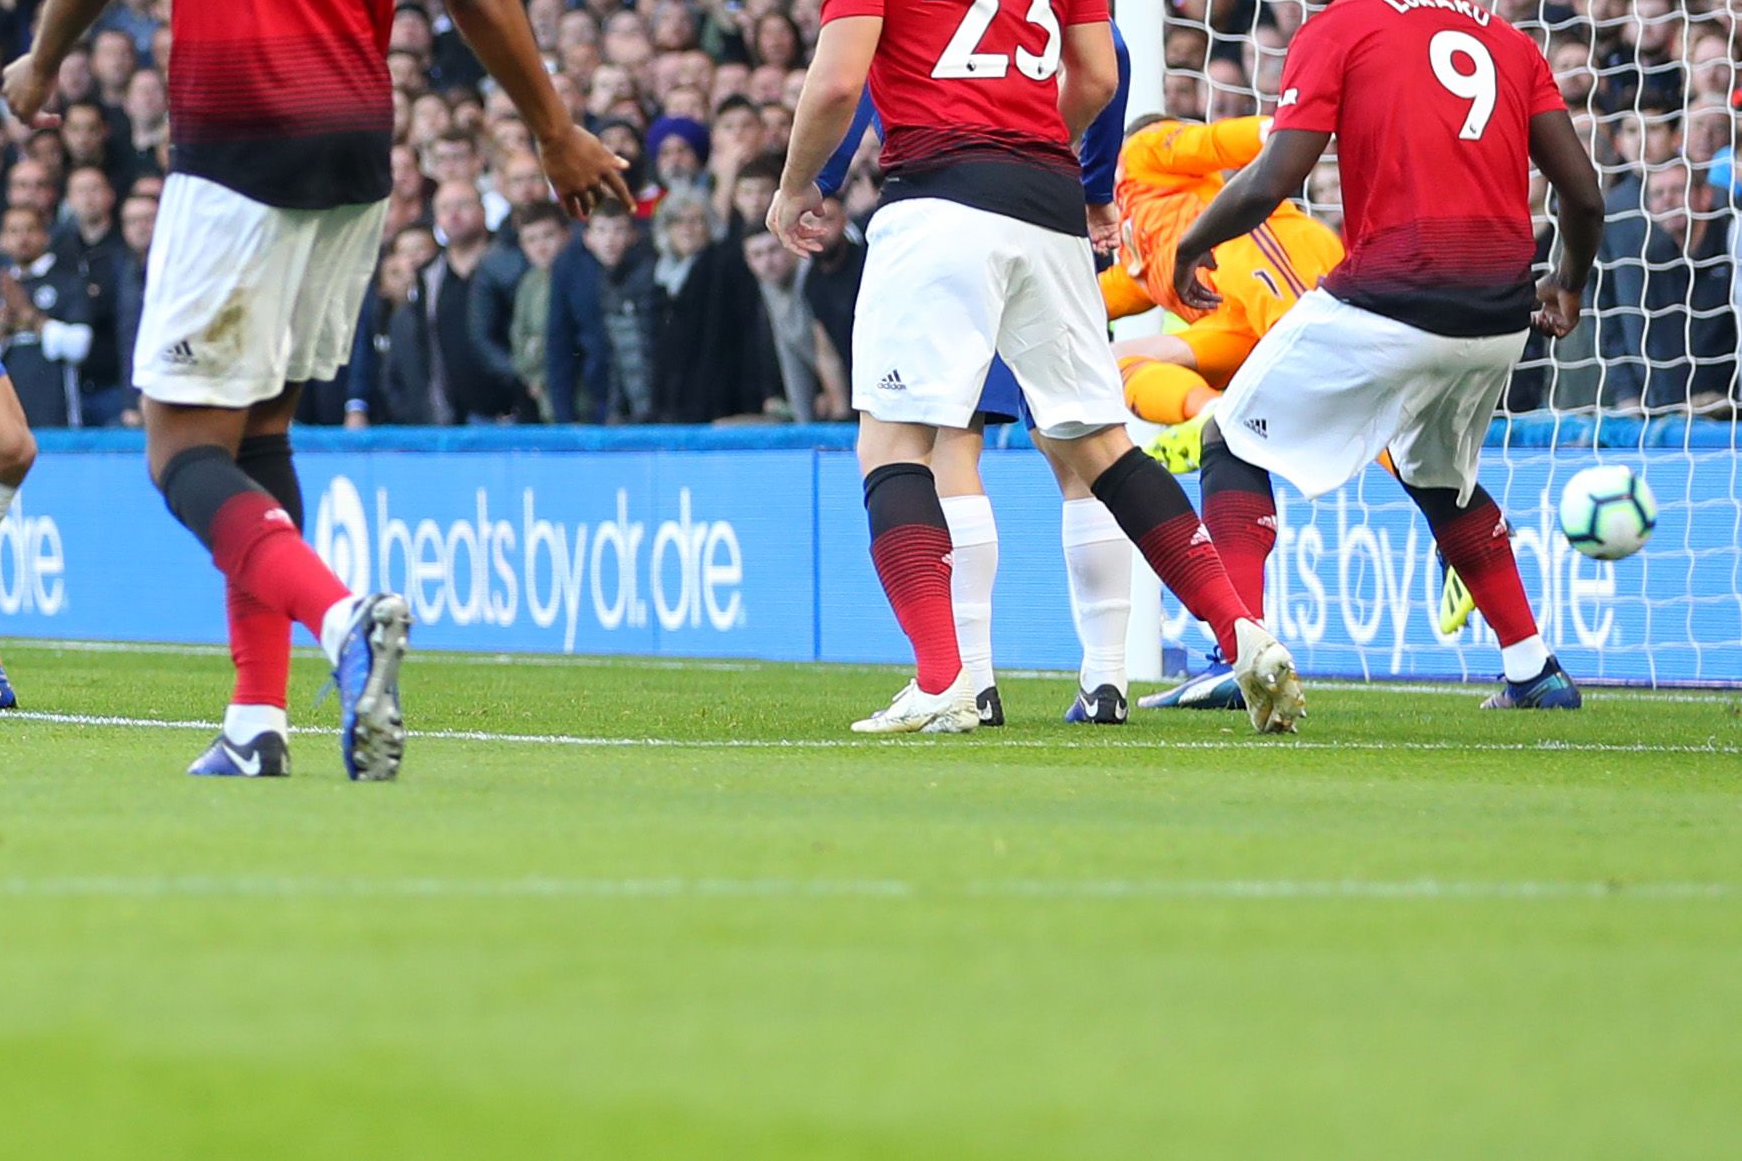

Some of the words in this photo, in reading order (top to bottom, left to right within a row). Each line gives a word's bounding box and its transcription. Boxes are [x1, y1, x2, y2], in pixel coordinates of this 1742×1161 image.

[1429, 30, 1497, 140] 9
[376, 486, 519, 627] beats
[523, 486, 589, 655] by
[590, 487, 647, 630] dr.
[649, 487, 743, 632] dre
[1337, 487, 1418, 676] by
